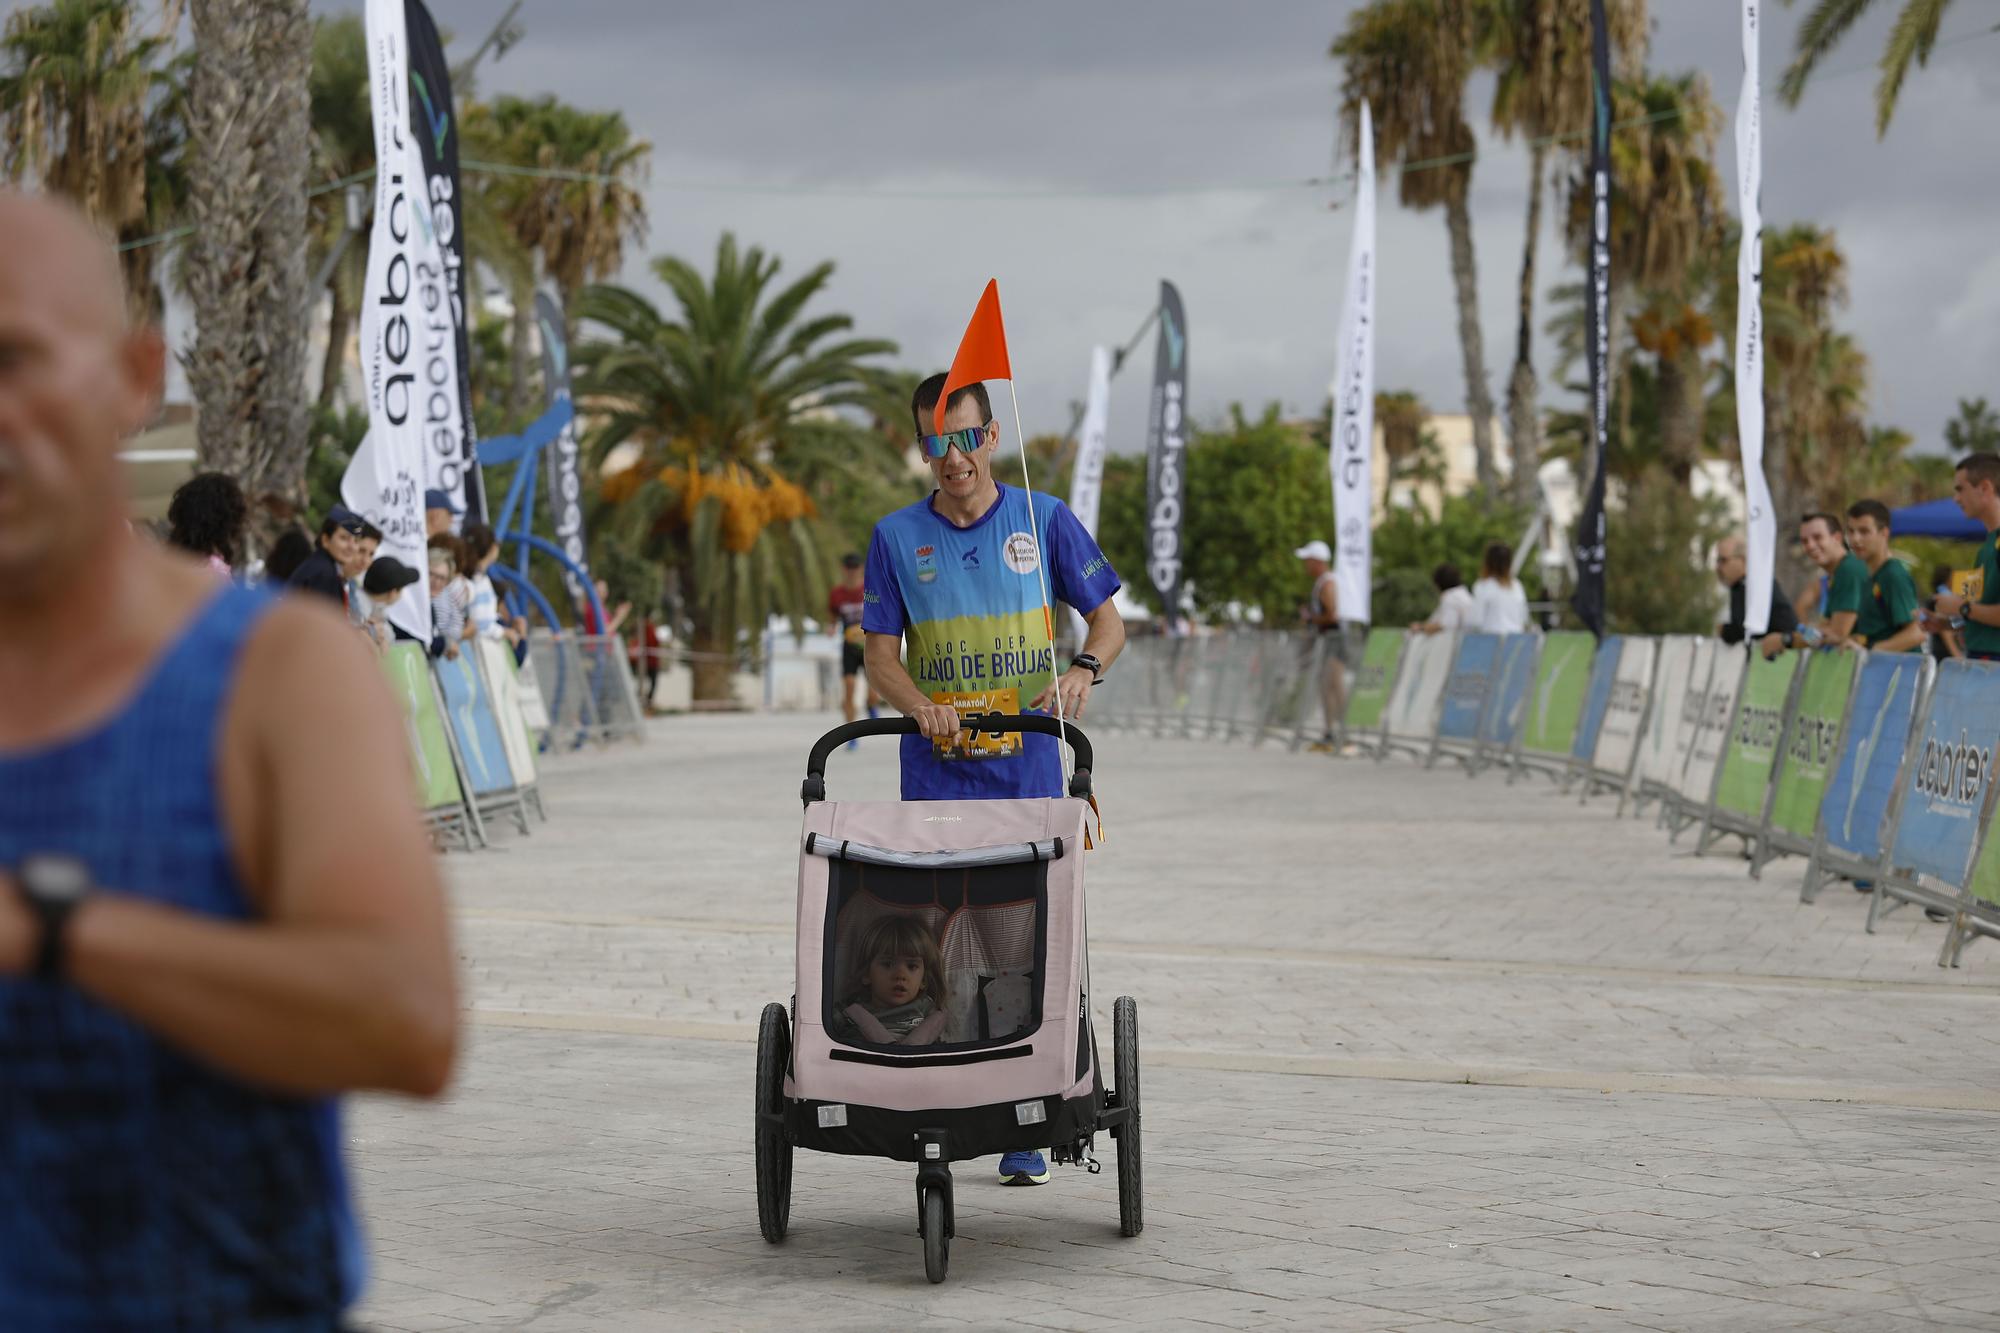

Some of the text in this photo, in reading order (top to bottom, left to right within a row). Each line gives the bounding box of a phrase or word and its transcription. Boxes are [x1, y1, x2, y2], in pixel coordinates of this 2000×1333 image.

[935, 635, 1034, 656] SOC. DEP.
[961, 654, 986, 679] DE
[991, 648, 1053, 678] BRUJAS
